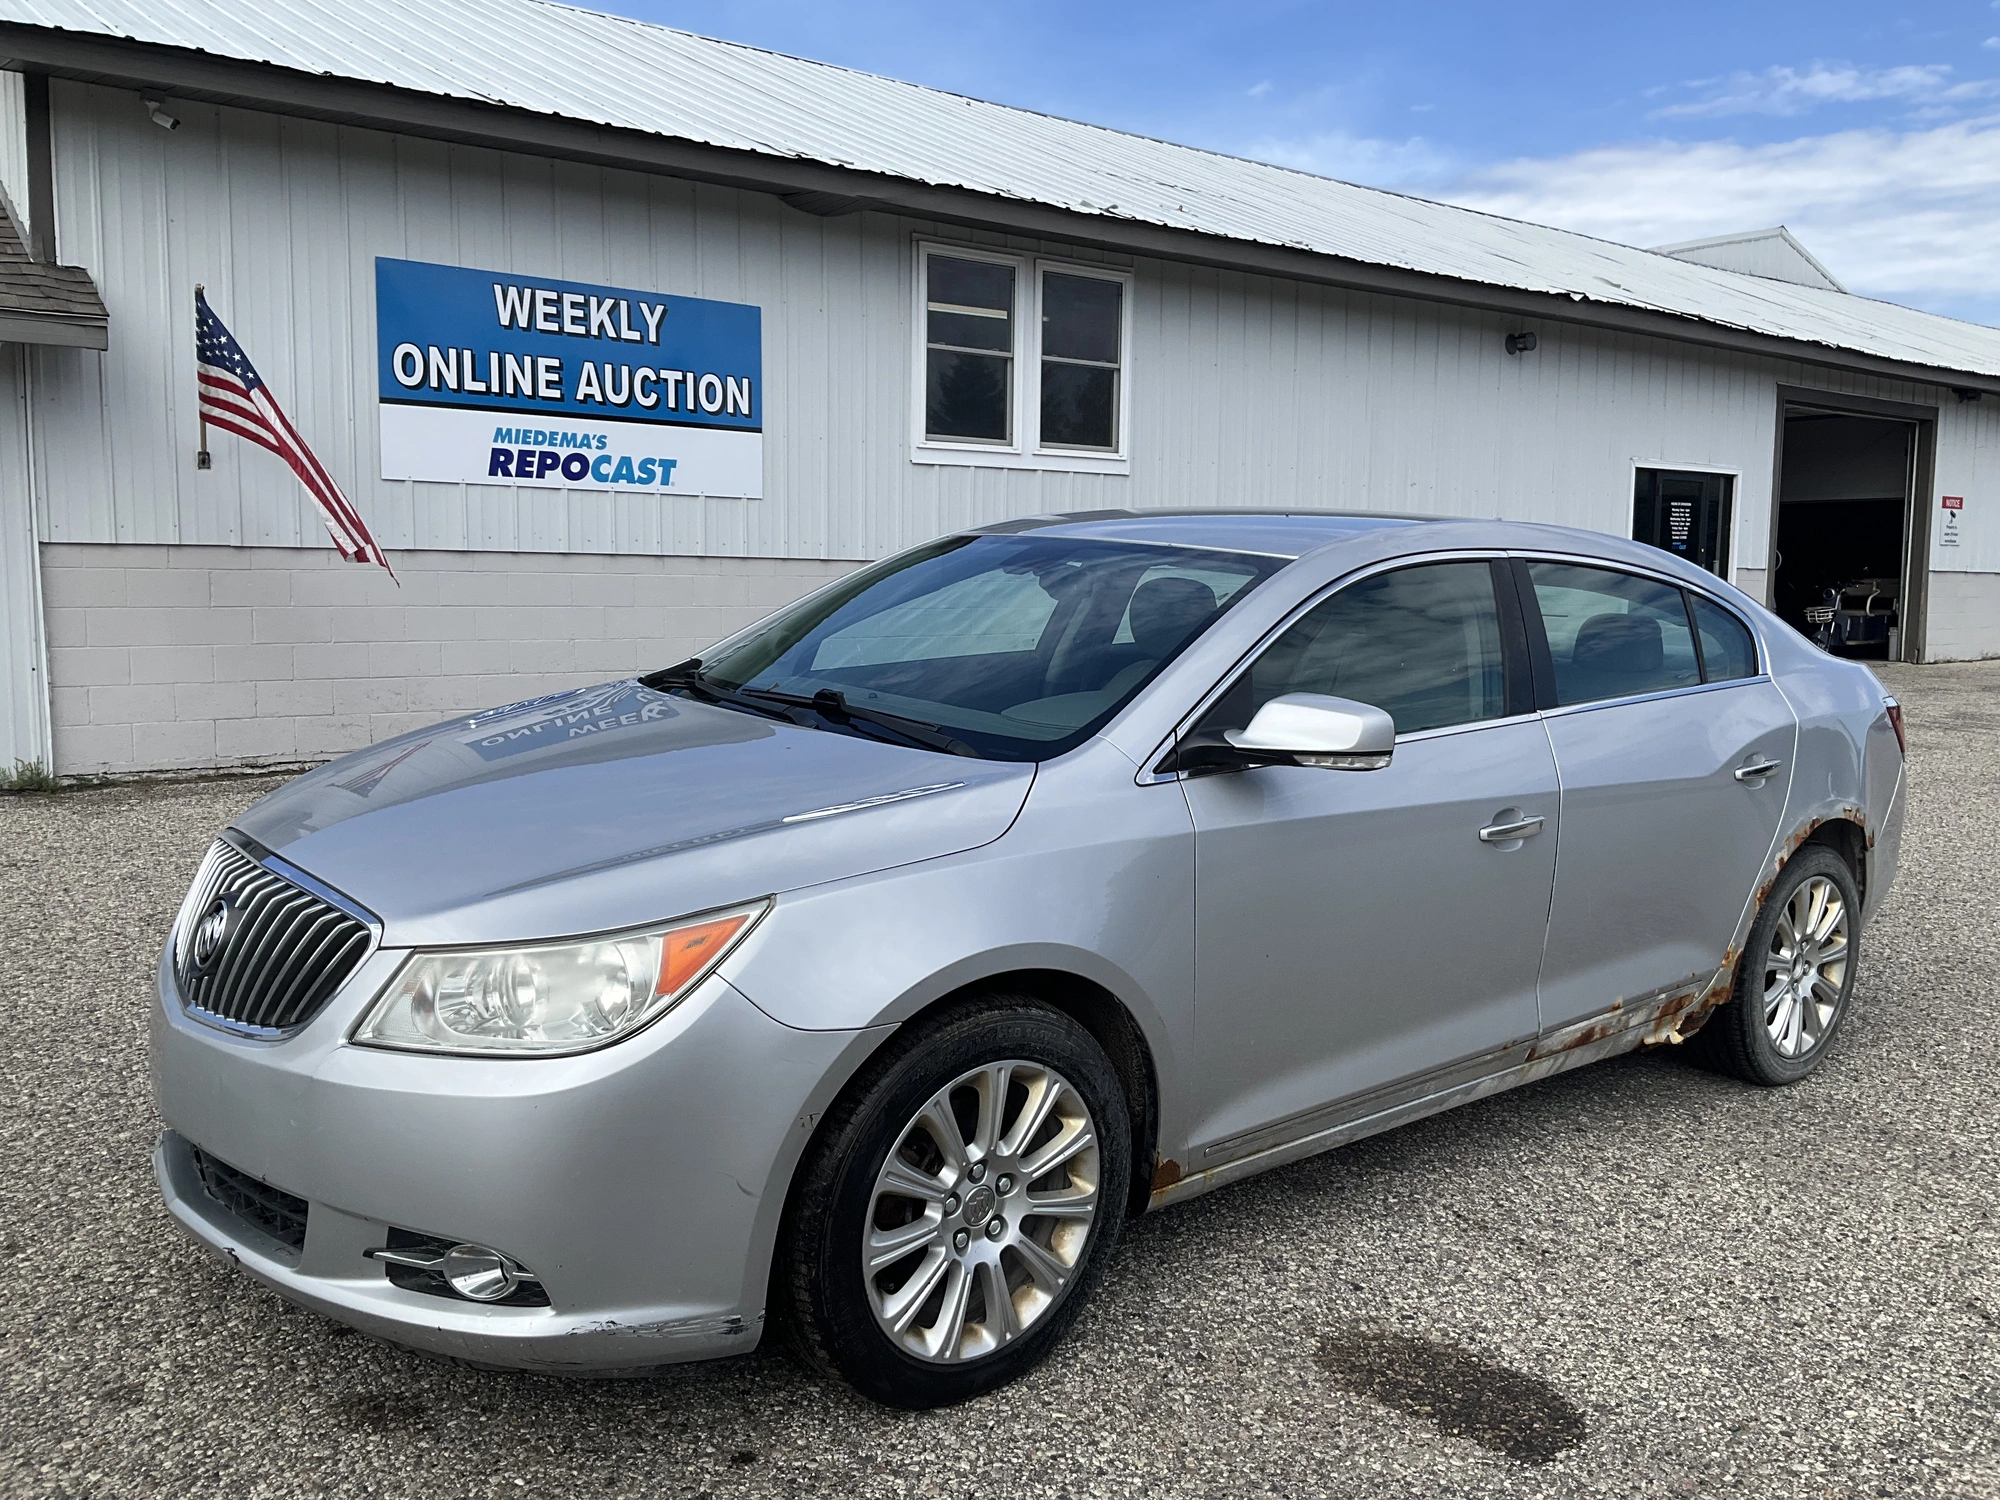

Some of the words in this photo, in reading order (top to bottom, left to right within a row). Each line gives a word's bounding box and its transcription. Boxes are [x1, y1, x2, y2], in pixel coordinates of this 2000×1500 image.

[493, 283, 666, 345] WEEKLY
[393, 342, 563, 400] ONLINE
[576, 361, 751, 417] AUCTION
[493, 427, 607, 450] MIEDEMA'S
[488, 448, 677, 487] REPOCAST
[1945, 499, 1961, 508] NOTICE
